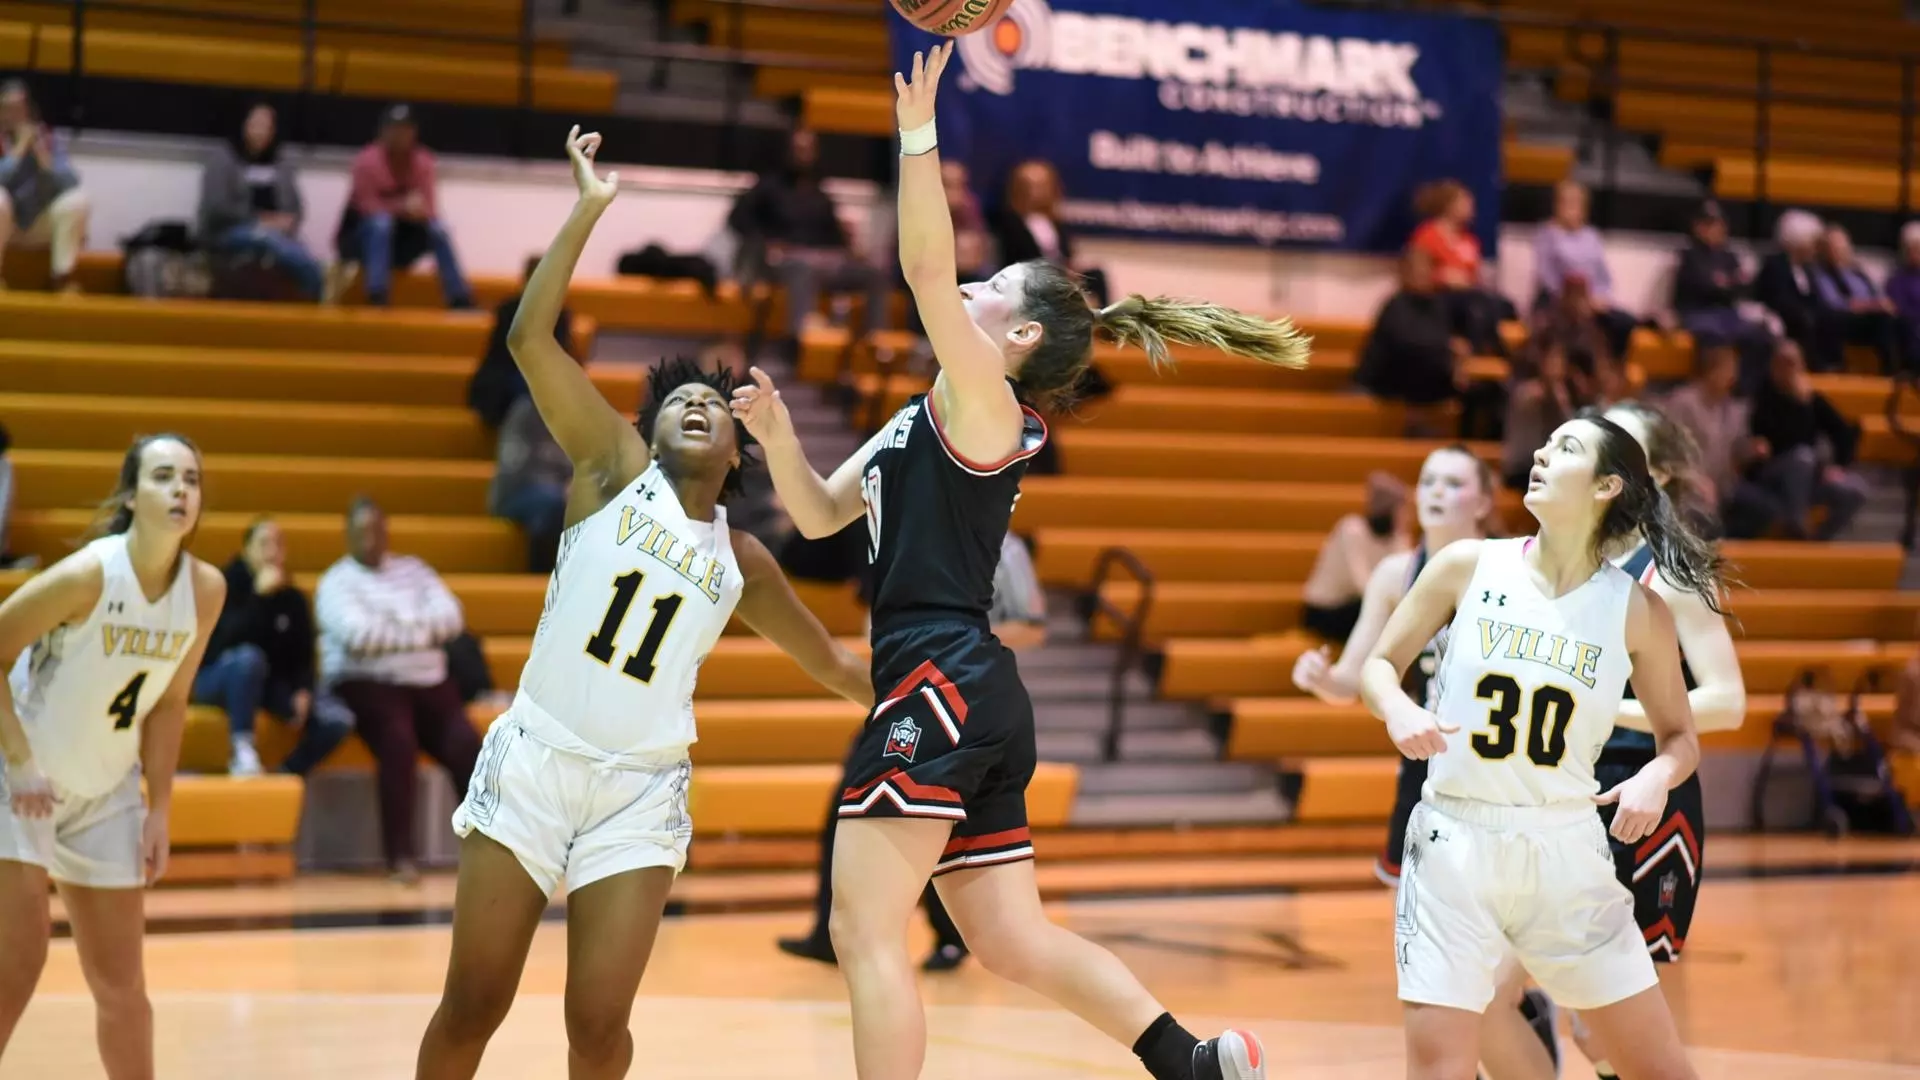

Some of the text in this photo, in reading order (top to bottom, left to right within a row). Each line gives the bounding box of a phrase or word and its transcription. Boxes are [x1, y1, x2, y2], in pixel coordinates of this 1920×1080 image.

[1050, 11, 1421, 99] BENCHMARK
[617, 505, 726, 604] VILLE
[584, 568, 686, 687] 11
[1477, 617, 1602, 689] VILLE
[107, 670, 150, 732] 4
[1469, 671, 1578, 769] 30
